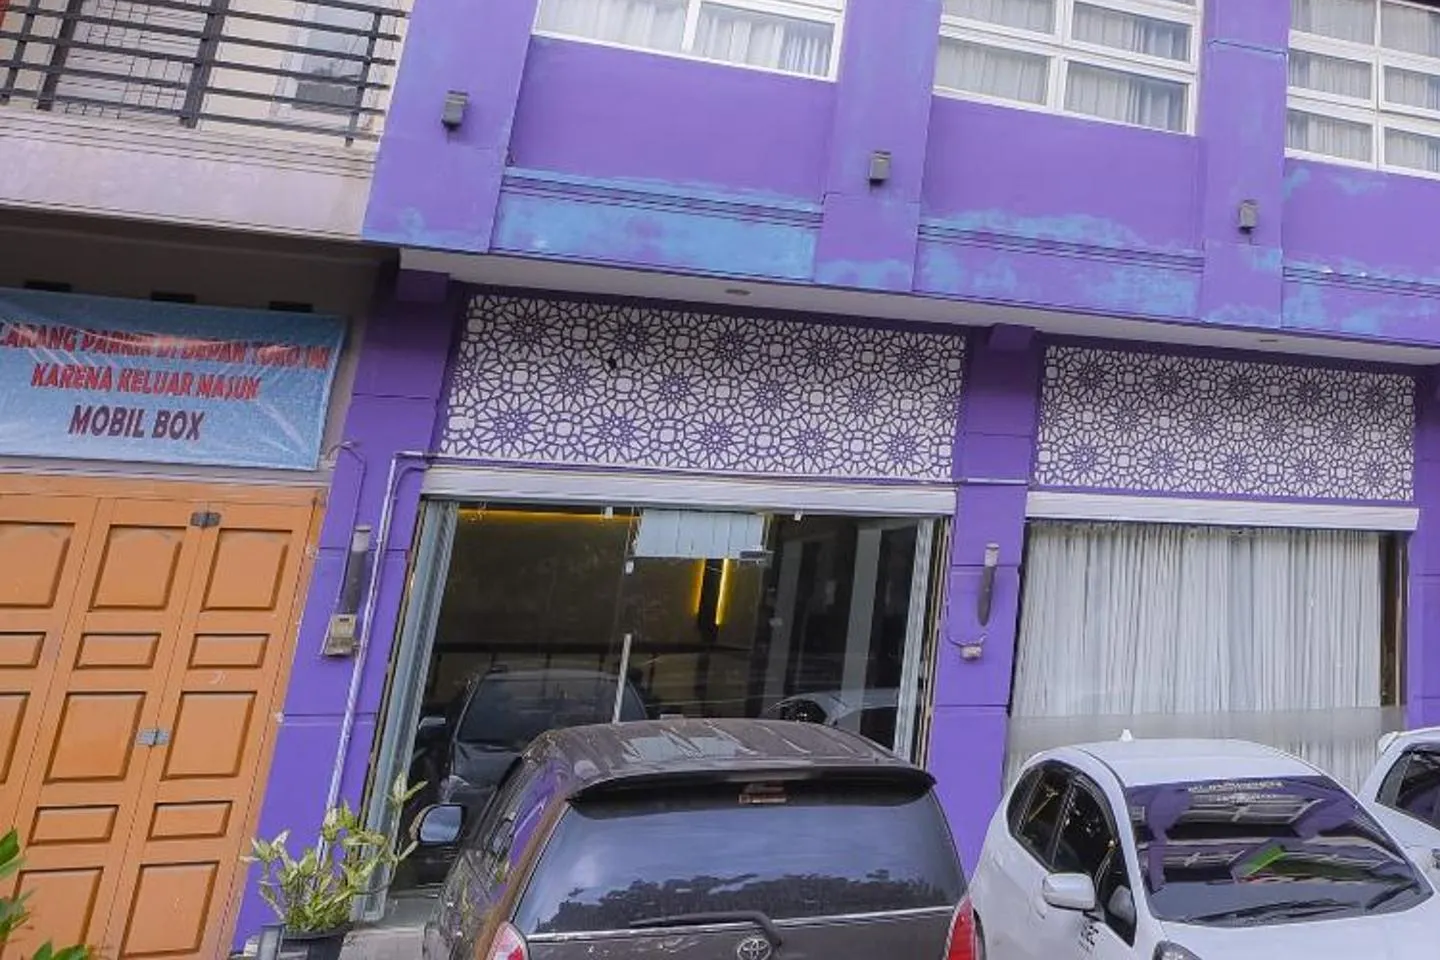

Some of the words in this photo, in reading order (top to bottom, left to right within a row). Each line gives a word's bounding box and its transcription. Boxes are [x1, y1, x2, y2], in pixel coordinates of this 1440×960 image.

[31, 361, 113, 392] KARENA
[68, 405, 147, 439] MOBIL
[152, 410, 206, 441] BOX
